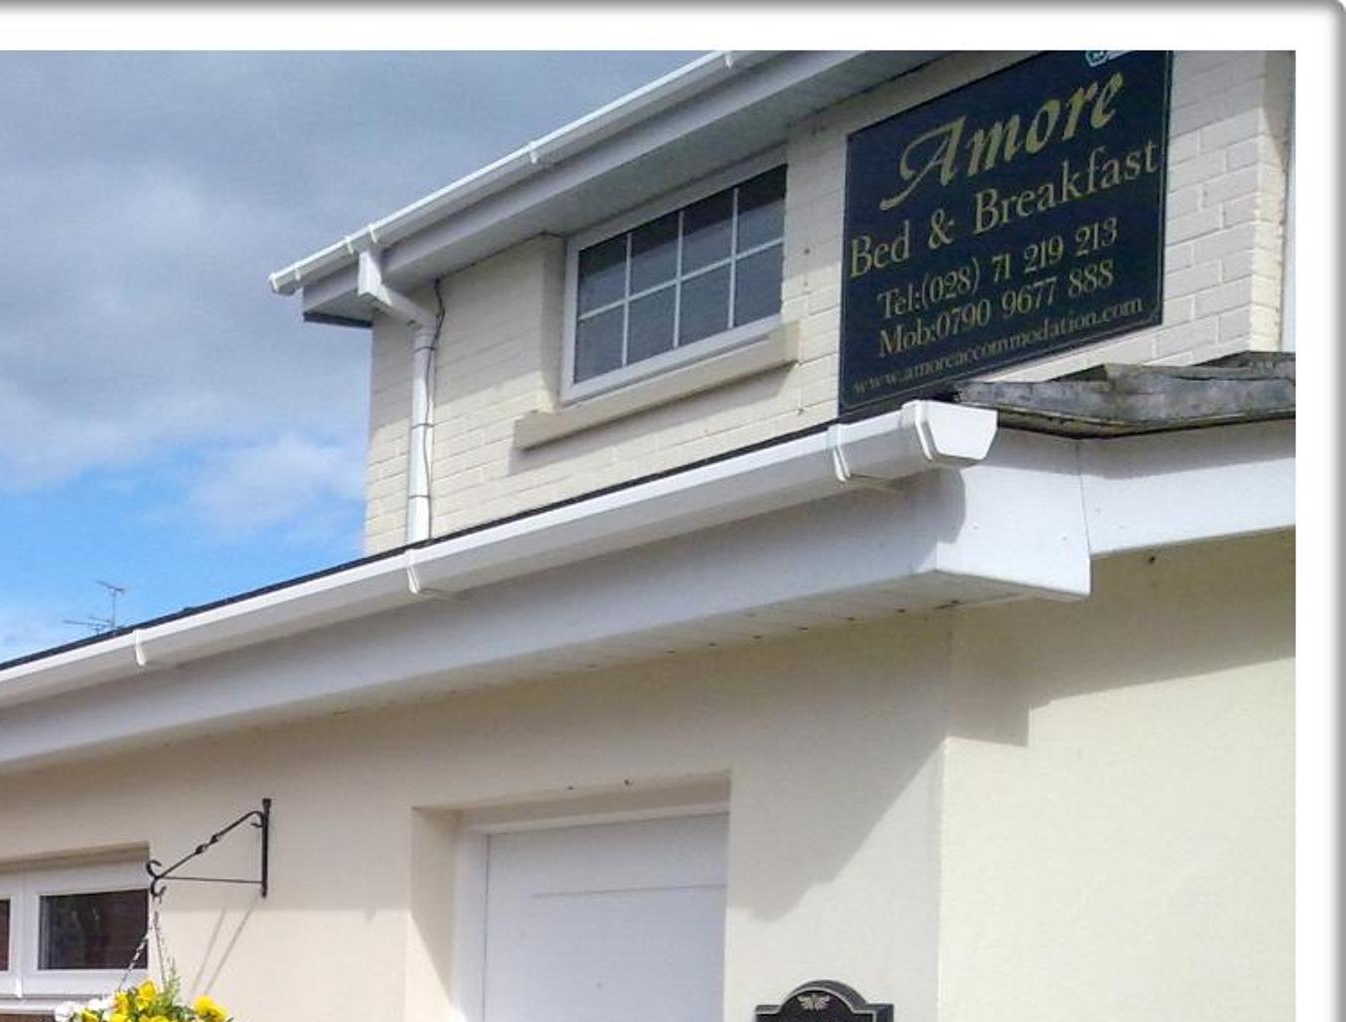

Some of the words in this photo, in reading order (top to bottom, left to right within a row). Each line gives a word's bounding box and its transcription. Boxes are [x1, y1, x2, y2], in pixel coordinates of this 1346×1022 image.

[881, 73, 1123, 210] Amore
[851, 221, 911, 277] Bed
[928, 210, 955, 249] &
[973, 140, 1159, 234] Breakfast
[992, 255, 1012, 282] 71
[1023, 236, 1064, 273] 219
[1075, 217, 1118, 256] 213
[1002, 278, 1056, 316] 9677
[1070, 260, 1114, 297] 888
[854, 298, 1143, 393] www.amoreaccommodation.com
